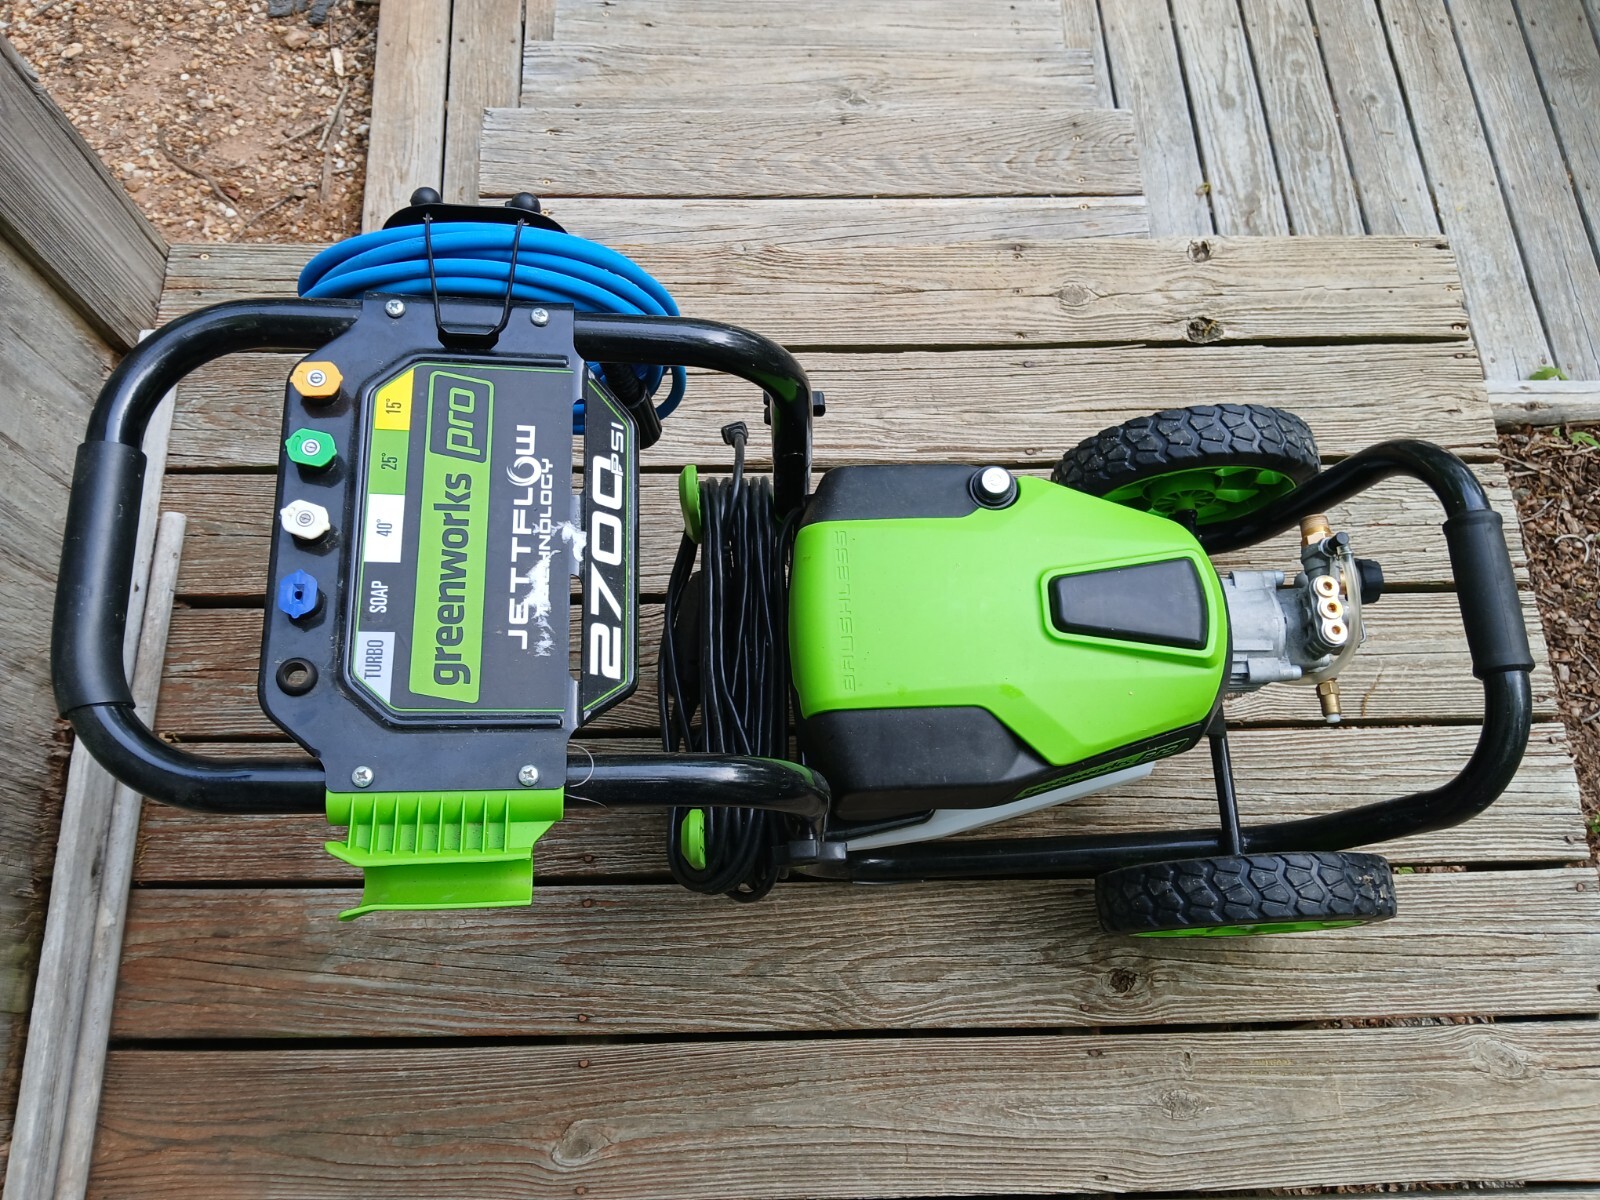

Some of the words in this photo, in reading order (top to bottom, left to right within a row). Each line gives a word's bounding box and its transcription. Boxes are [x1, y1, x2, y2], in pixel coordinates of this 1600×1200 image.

[446, 387, 481, 456] pro
[369, 580, 389, 614] SOAP
[433, 472, 473, 686] greenworks
[507, 424, 542, 650] JETTFLOW
[535, 458, 554, 613] HNOLOGY
[589, 455, 622, 680] 2700
[610, 422, 625, 477] PSI
[835, 530, 856, 692] BRUSHLESS
[364, 639, 385, 680] TURBO
